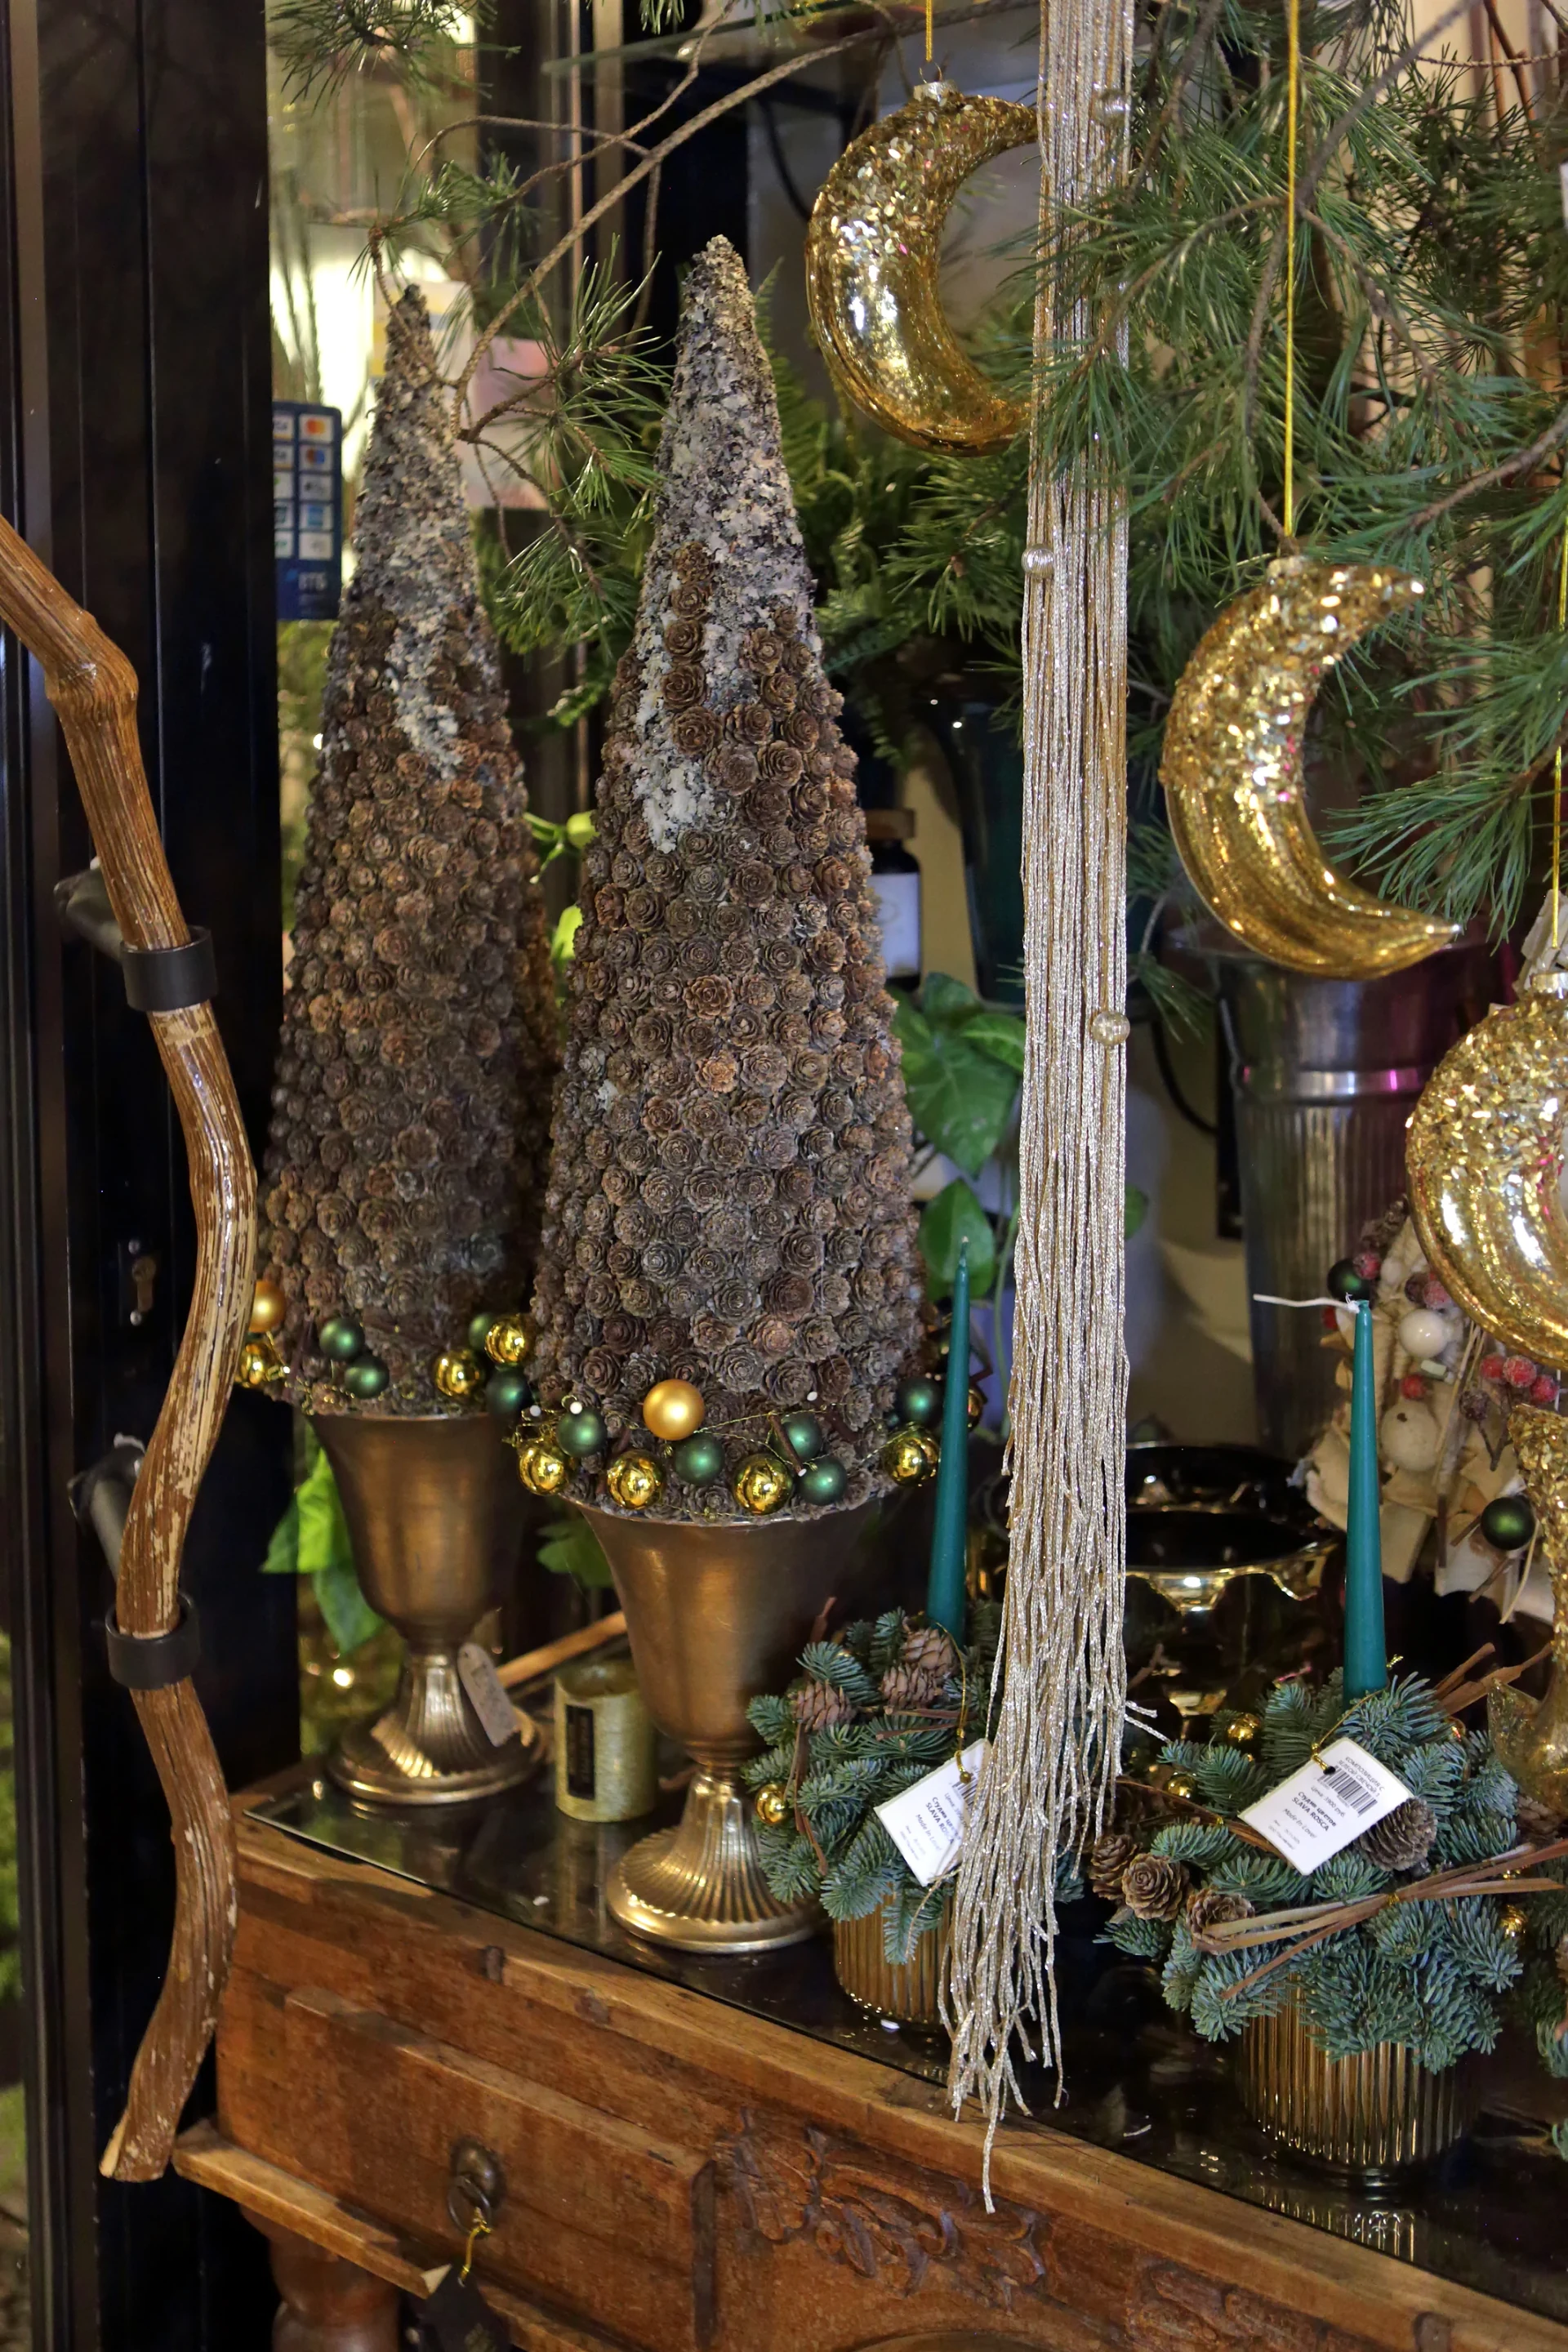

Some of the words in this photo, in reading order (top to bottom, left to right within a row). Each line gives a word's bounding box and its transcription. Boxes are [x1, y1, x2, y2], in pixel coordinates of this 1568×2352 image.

[1356, 1775, 1379, 1793] СВЕЧОЙ
[925, 1802, 942, 1824] SLAVA
[931, 1797, 947, 1819] Студия
[1282, 1808, 1298, 1821] Made
[1292, 1797, 1311, 1813] SLAVA
[1310, 1811, 1330, 1832] ROSCA
[1298, 1791, 1317, 1808] Студия
[1316, 1807, 1337, 1827] цветов
[915, 1814, 928, 1830] Made
